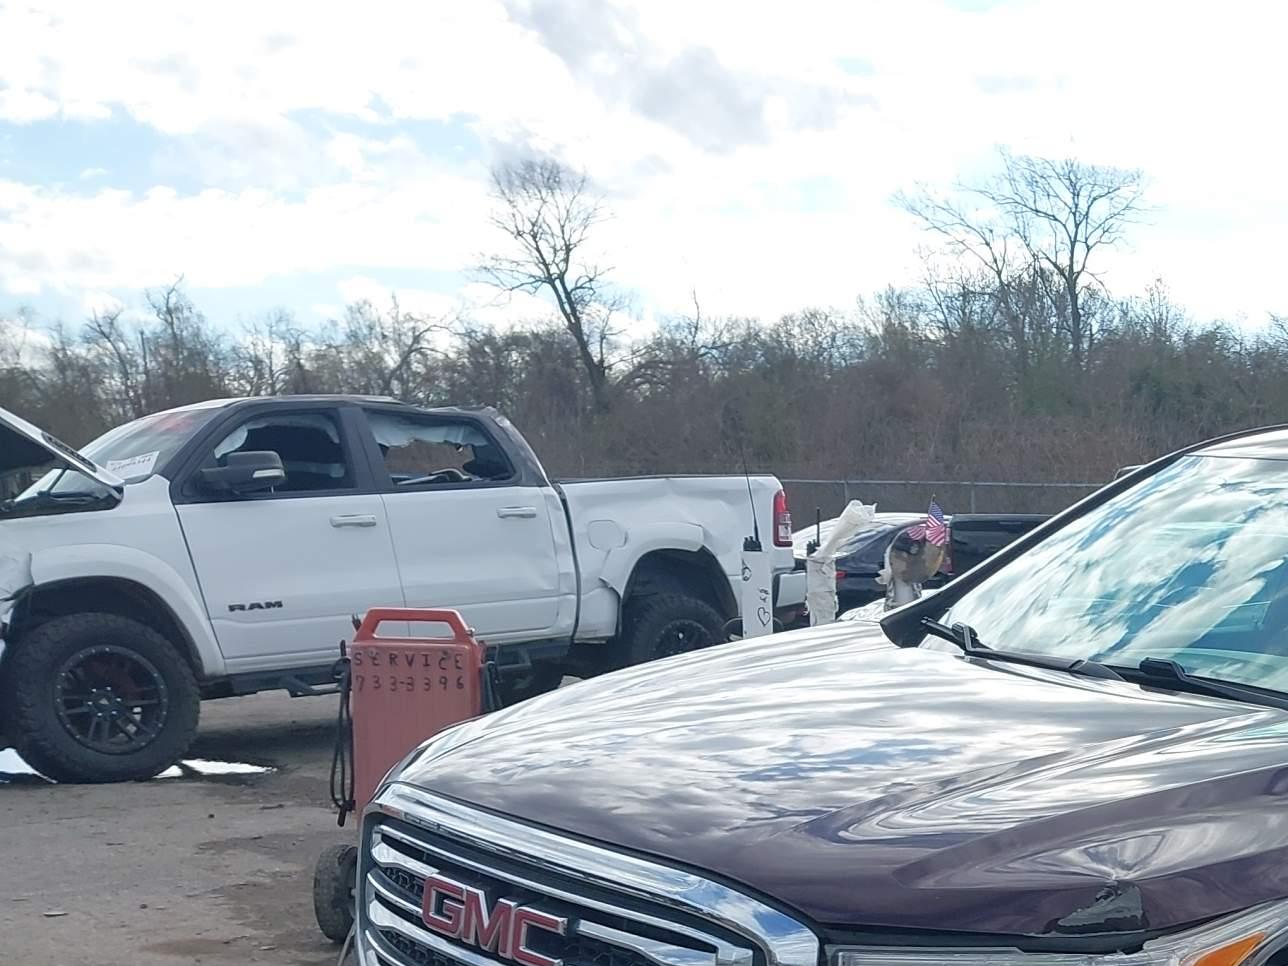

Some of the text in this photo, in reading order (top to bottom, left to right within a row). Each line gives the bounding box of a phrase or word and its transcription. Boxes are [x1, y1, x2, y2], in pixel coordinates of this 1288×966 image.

[228, 600, 284, 612] RAM
[353, 651, 463, 671] SERVICE
[355, 676, 465, 693] 733-3396
